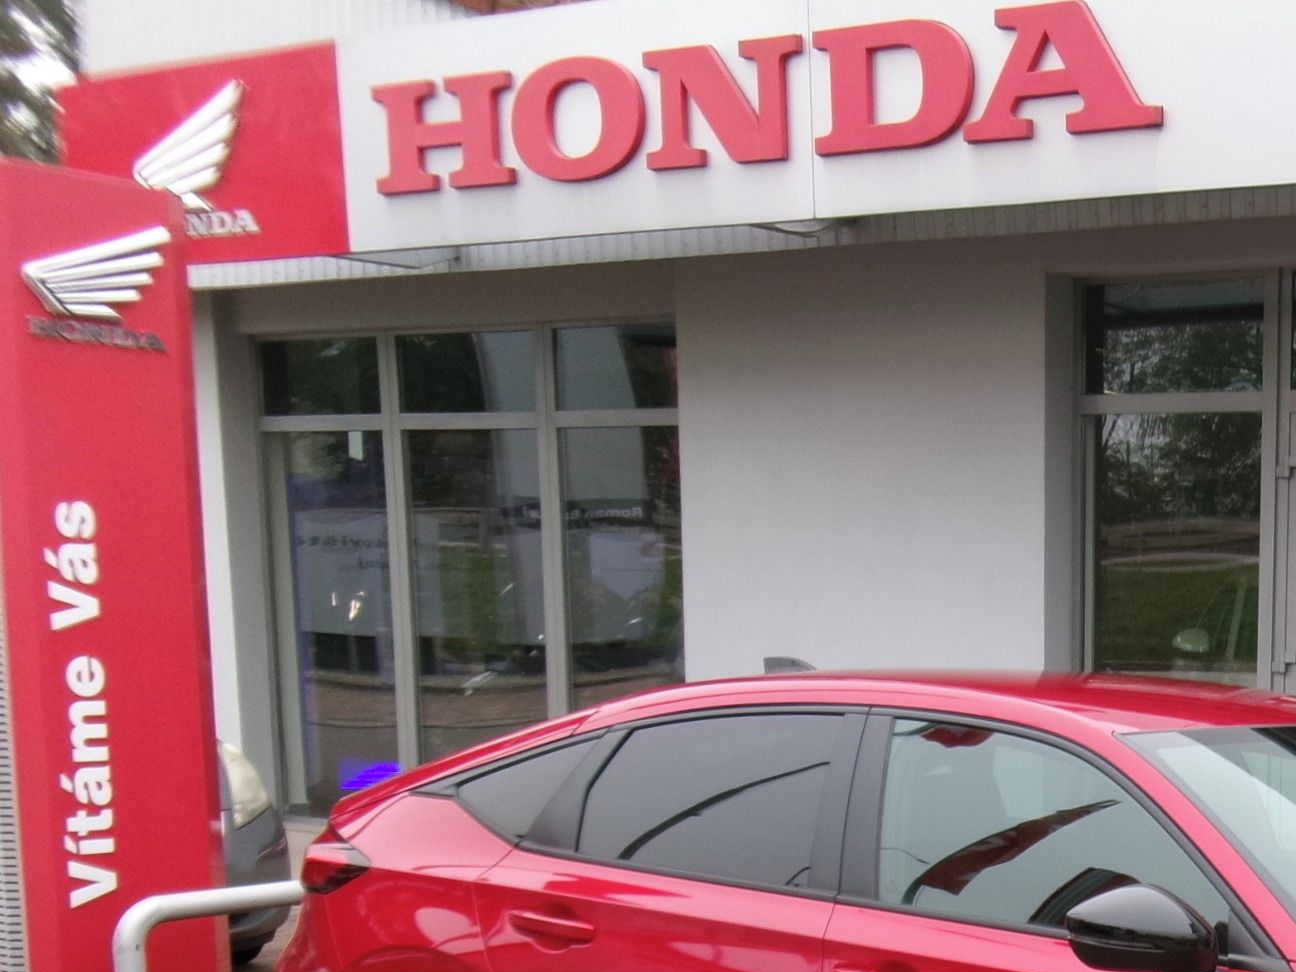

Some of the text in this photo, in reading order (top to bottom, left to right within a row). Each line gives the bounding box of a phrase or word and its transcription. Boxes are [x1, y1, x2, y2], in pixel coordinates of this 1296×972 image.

[371, 0, 1164, 196] HONDA
[186, 208, 261, 237] NDA
[26, 314, 168, 353] HONDA
[43, 500, 118, 910] Vítáme Vás
